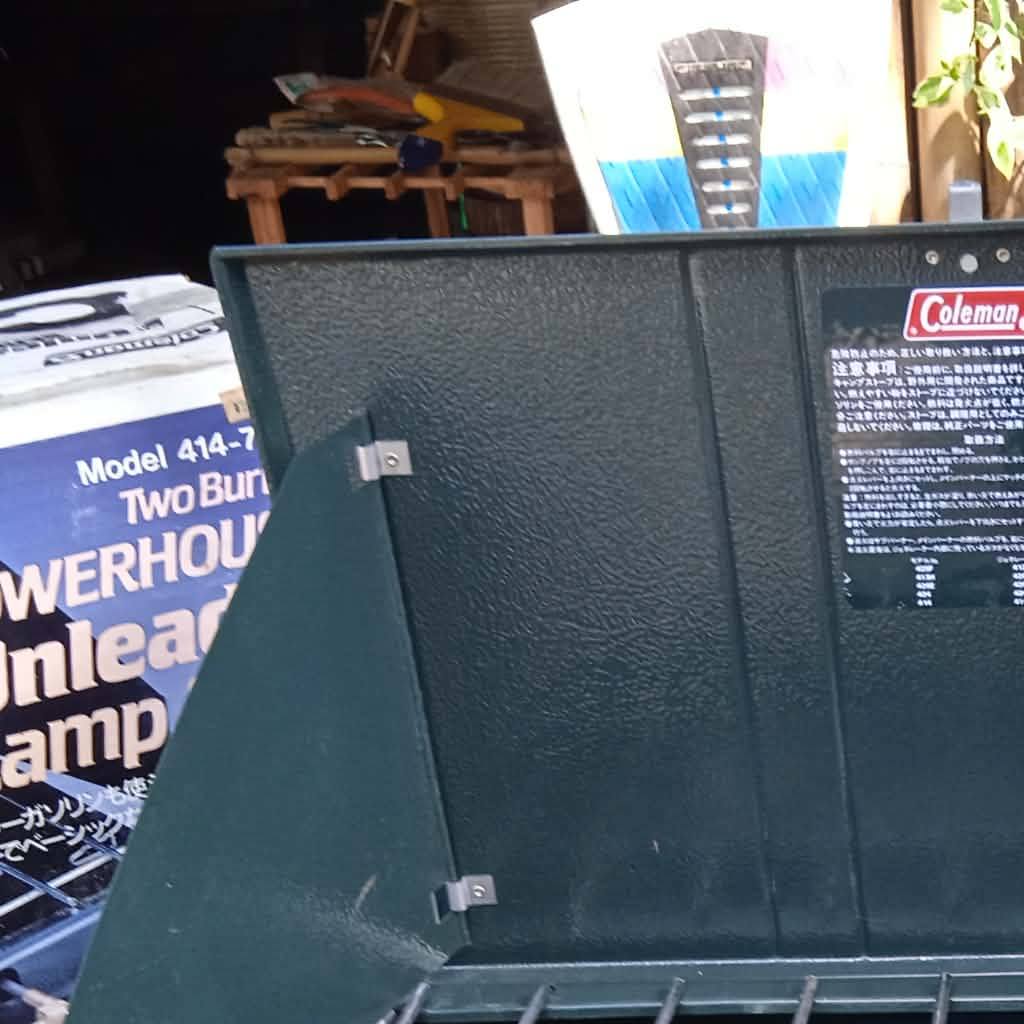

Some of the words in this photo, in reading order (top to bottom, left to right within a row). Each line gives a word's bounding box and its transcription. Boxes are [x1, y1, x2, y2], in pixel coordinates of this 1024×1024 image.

[919, 294, 1019, 332] Coleman
[76, 444, 168, 487] Model
[119, 484, 195, 525] Two
[0, 510, 271, 622] WERHOU
[0, 696, 169, 789] amp
